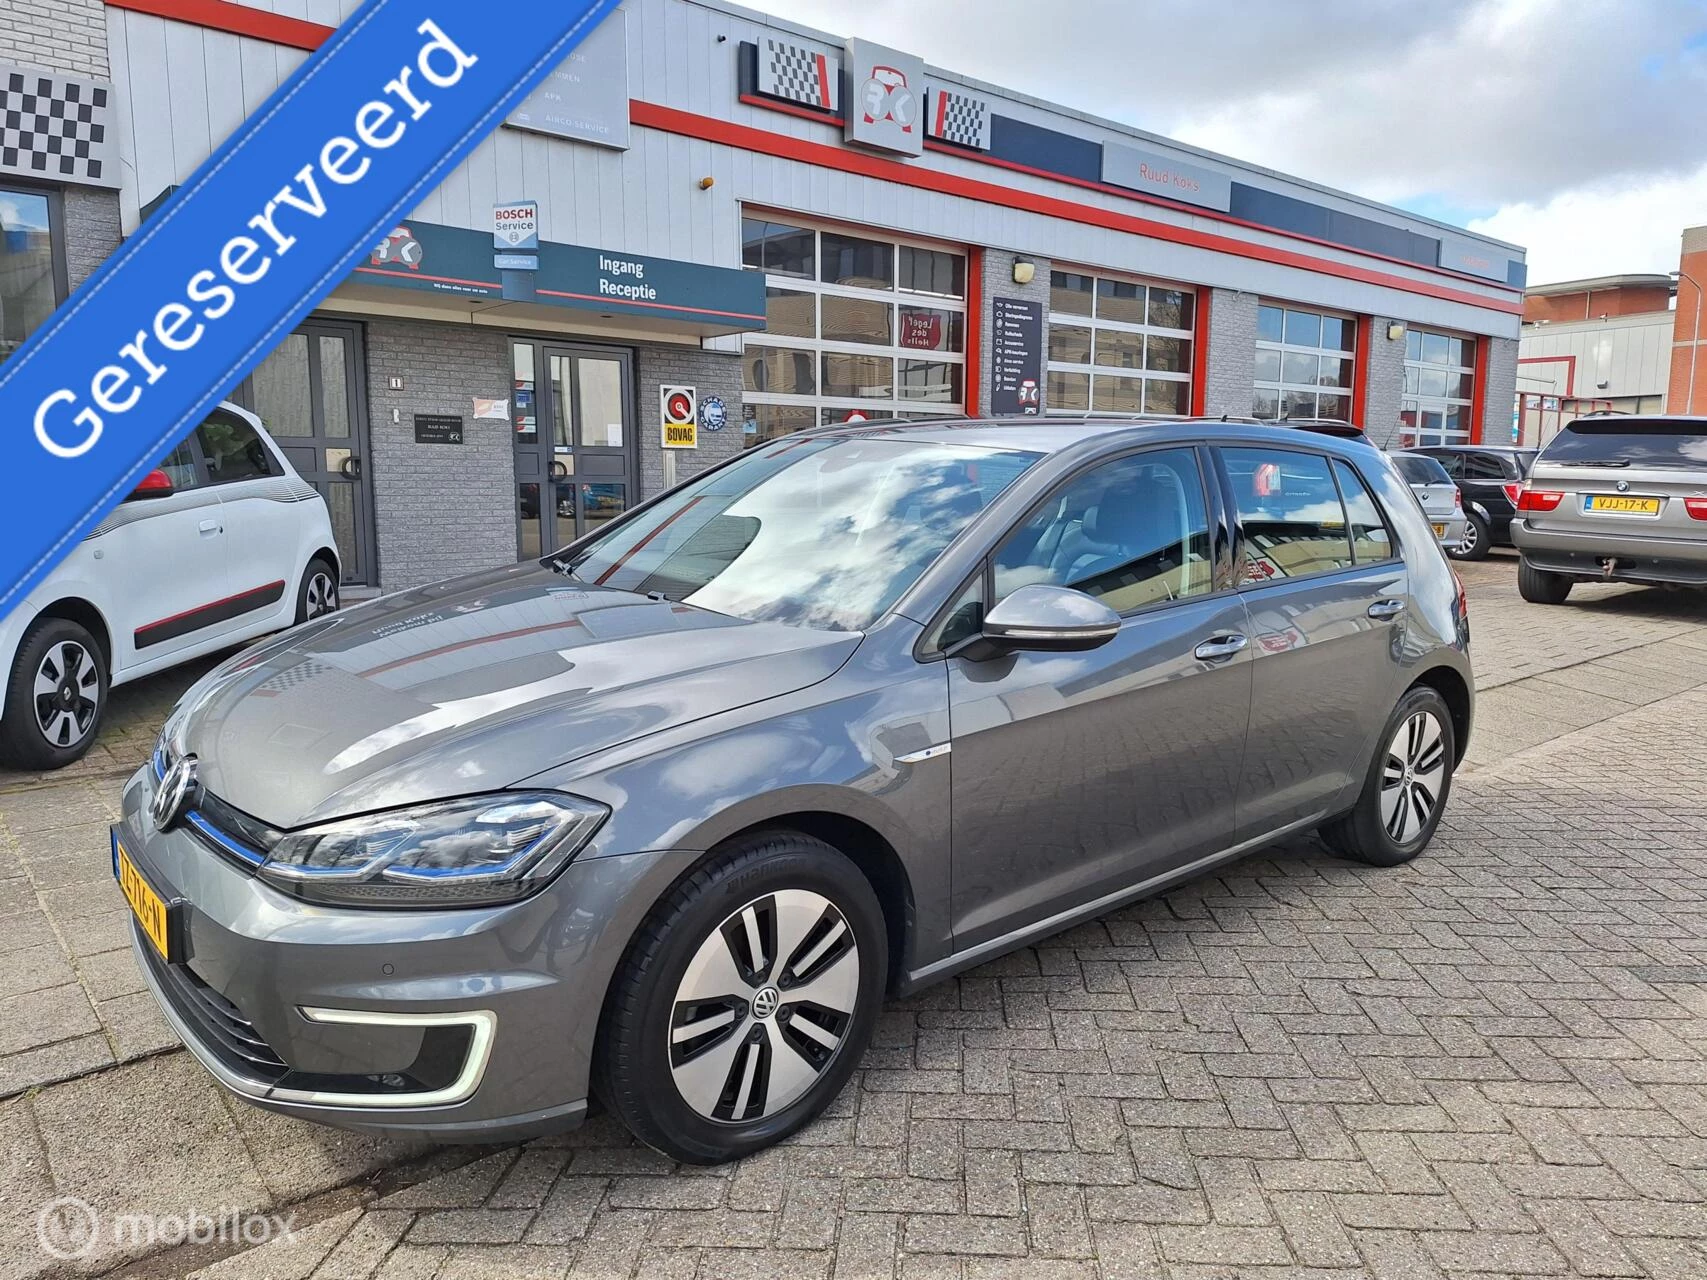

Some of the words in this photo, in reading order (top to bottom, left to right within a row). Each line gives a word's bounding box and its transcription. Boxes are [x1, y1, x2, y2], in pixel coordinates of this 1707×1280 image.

[1139, 162, 1169, 184] Ruud
[1172, 174, 1201, 192] Koks
[495, 208, 534, 221] BOSCH
[495, 221, 534, 231] Service
[599, 254, 644, 279] Ingang
[599, 278, 657, 301] Receptie
[667, 427, 693, 442] BOVAG
[1599, 498, 1649, 511] VJJ-17-K
